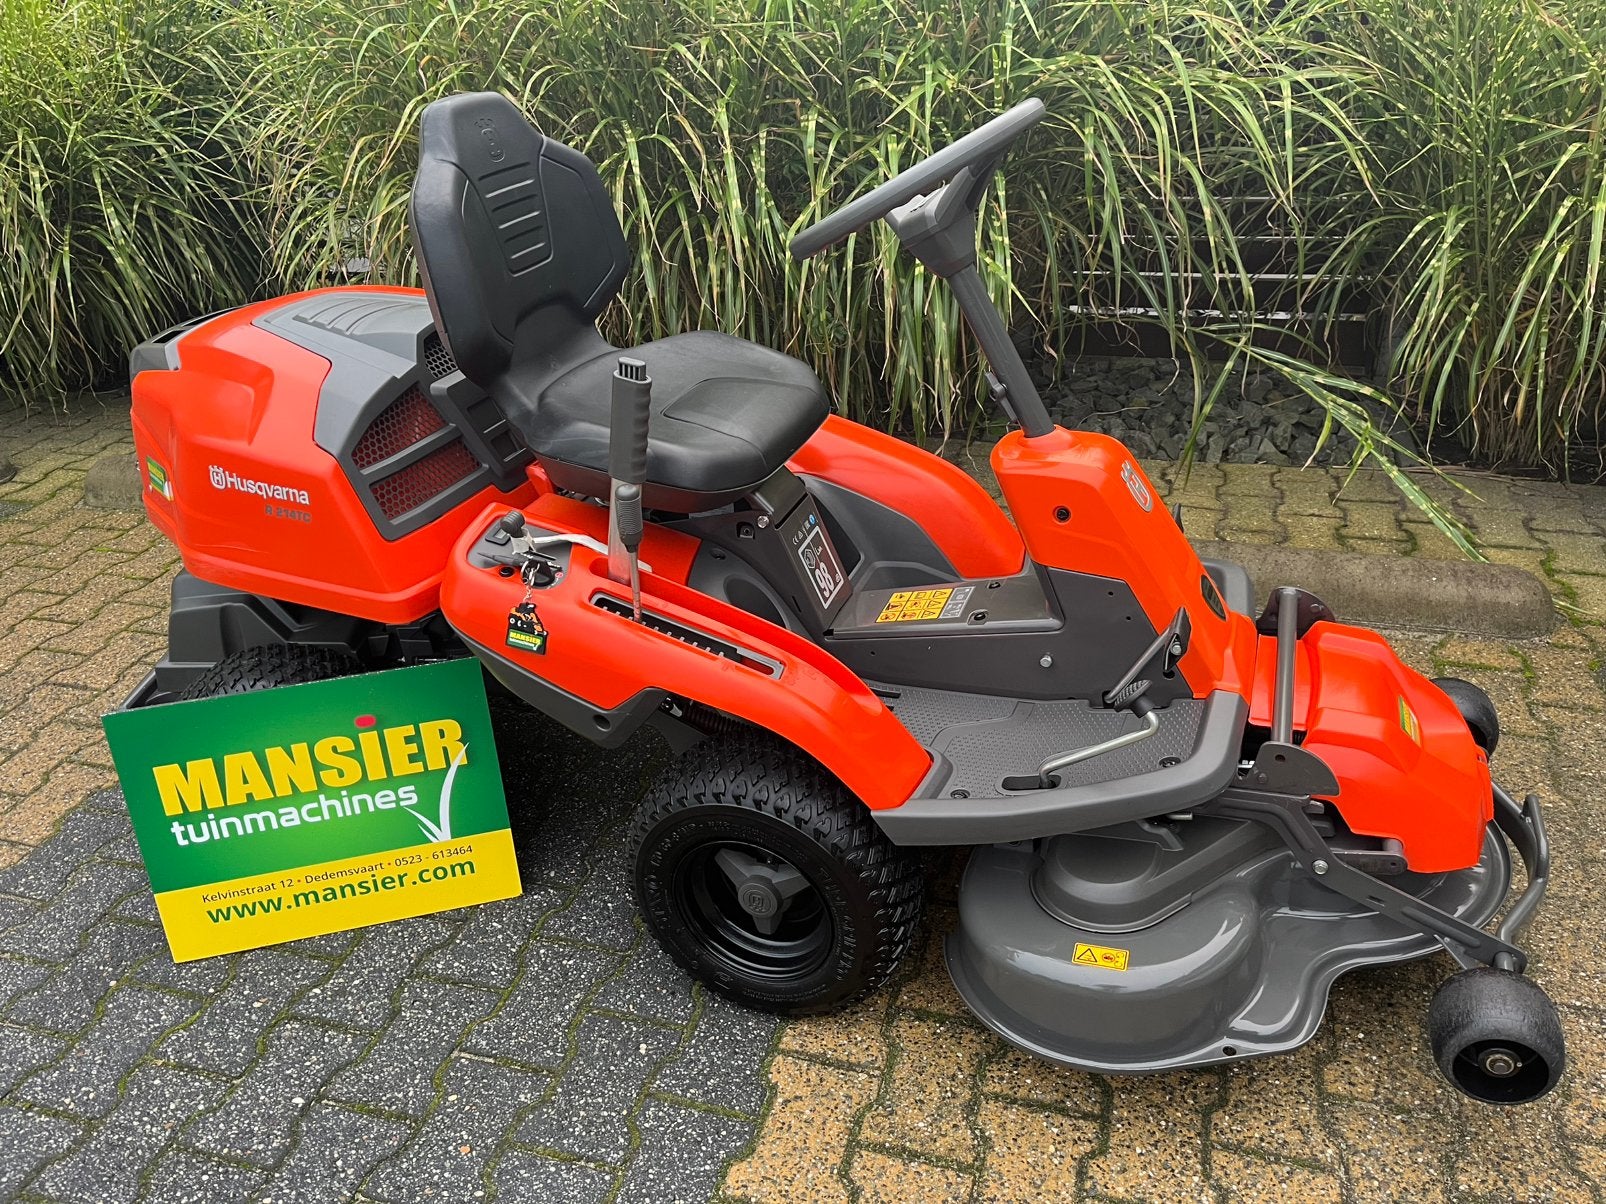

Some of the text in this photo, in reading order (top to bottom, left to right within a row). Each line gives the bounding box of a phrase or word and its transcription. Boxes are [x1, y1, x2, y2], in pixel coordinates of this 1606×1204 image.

[225, 471, 310, 505] Husqvarna
[276, 507, 311, 522] 214TC
[815, 561, 835, 598] 98
[170, 784, 418, 847] tuinmachines
[202, 845, 473, 904] Kelvinstraat 12 Dedemsvaart 0523 613464
[207, 860, 476, 924] www.mansier.com
